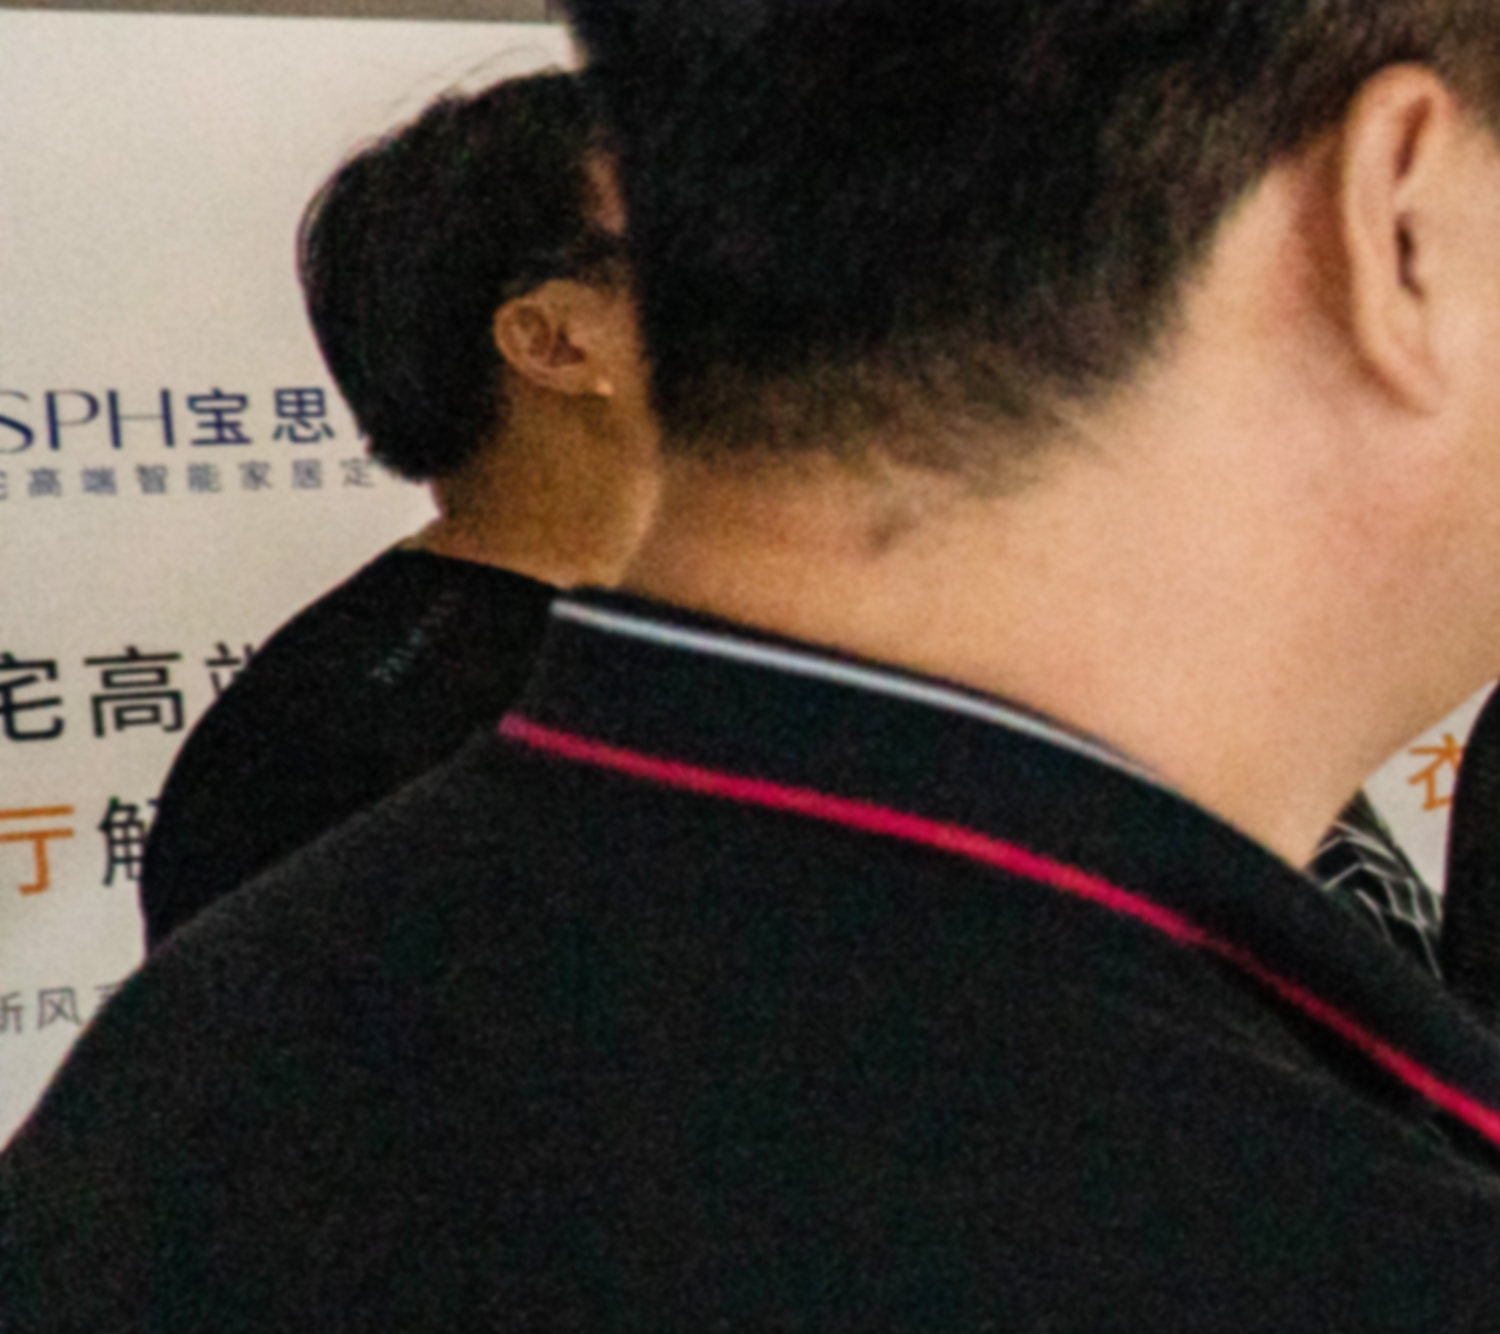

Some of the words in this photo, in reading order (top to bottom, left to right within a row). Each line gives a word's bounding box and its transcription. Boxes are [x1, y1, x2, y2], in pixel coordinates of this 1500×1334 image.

[0, 458, 376, 502] 高端智能家居定
